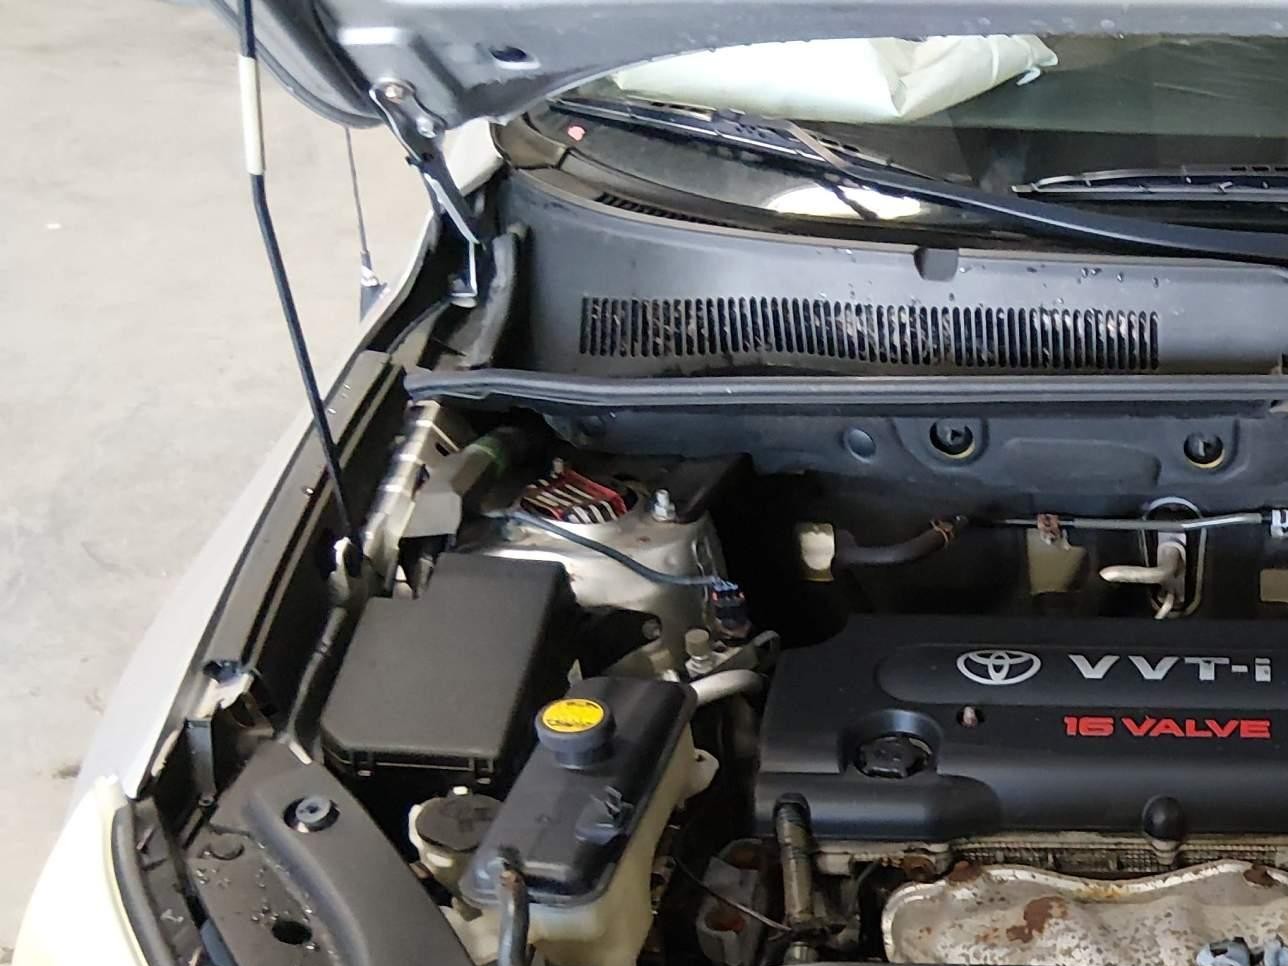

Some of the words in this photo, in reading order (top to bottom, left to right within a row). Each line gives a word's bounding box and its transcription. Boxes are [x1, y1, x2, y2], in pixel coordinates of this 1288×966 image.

[1068, 654, 1272, 682] VVT-i
[1063, 715, 1115, 737] 16
[1121, 715, 1271, 739] VALVE
